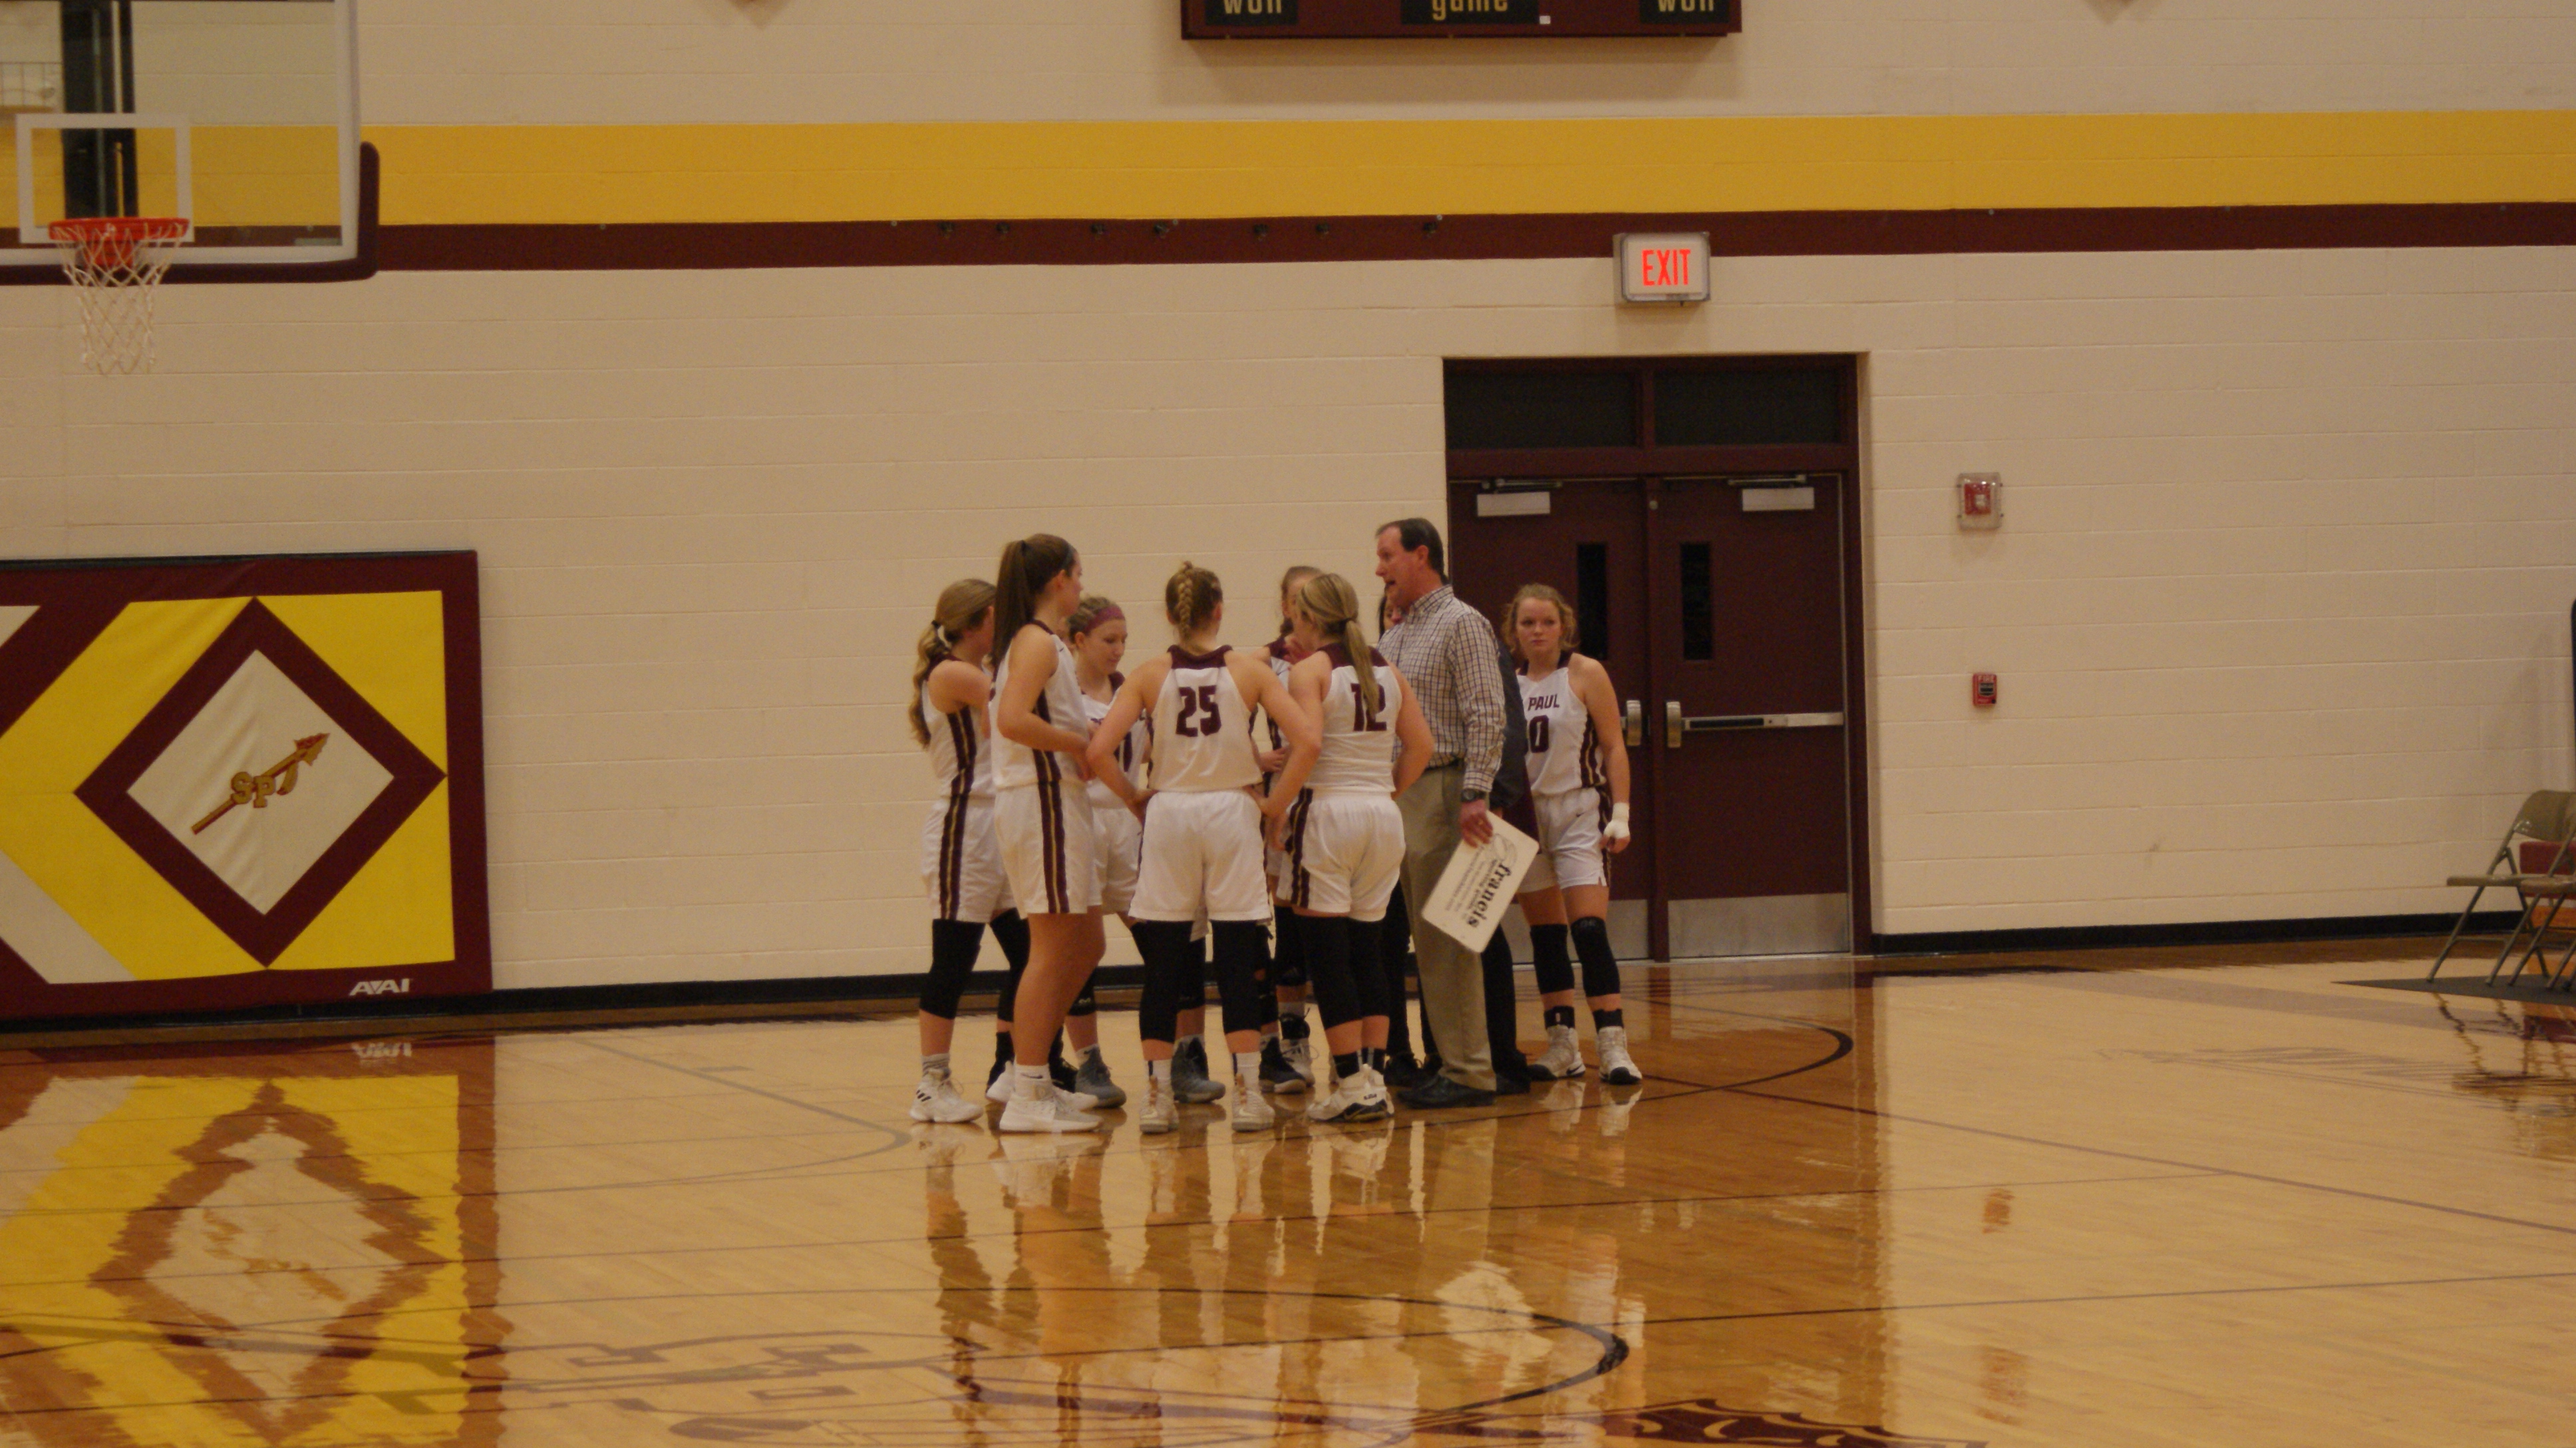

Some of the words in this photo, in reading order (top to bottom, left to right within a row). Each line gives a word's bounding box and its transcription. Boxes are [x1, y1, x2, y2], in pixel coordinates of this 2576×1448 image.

[1641, 249, 1690, 286] EXIT
[1176, 685, 1222, 737] 25
[1528, 694, 1559, 711] PAUL
[1530, 715, 1549, 753] 0
[230, 772, 276, 809] SP
[1468, 861, 1512, 928] francis
